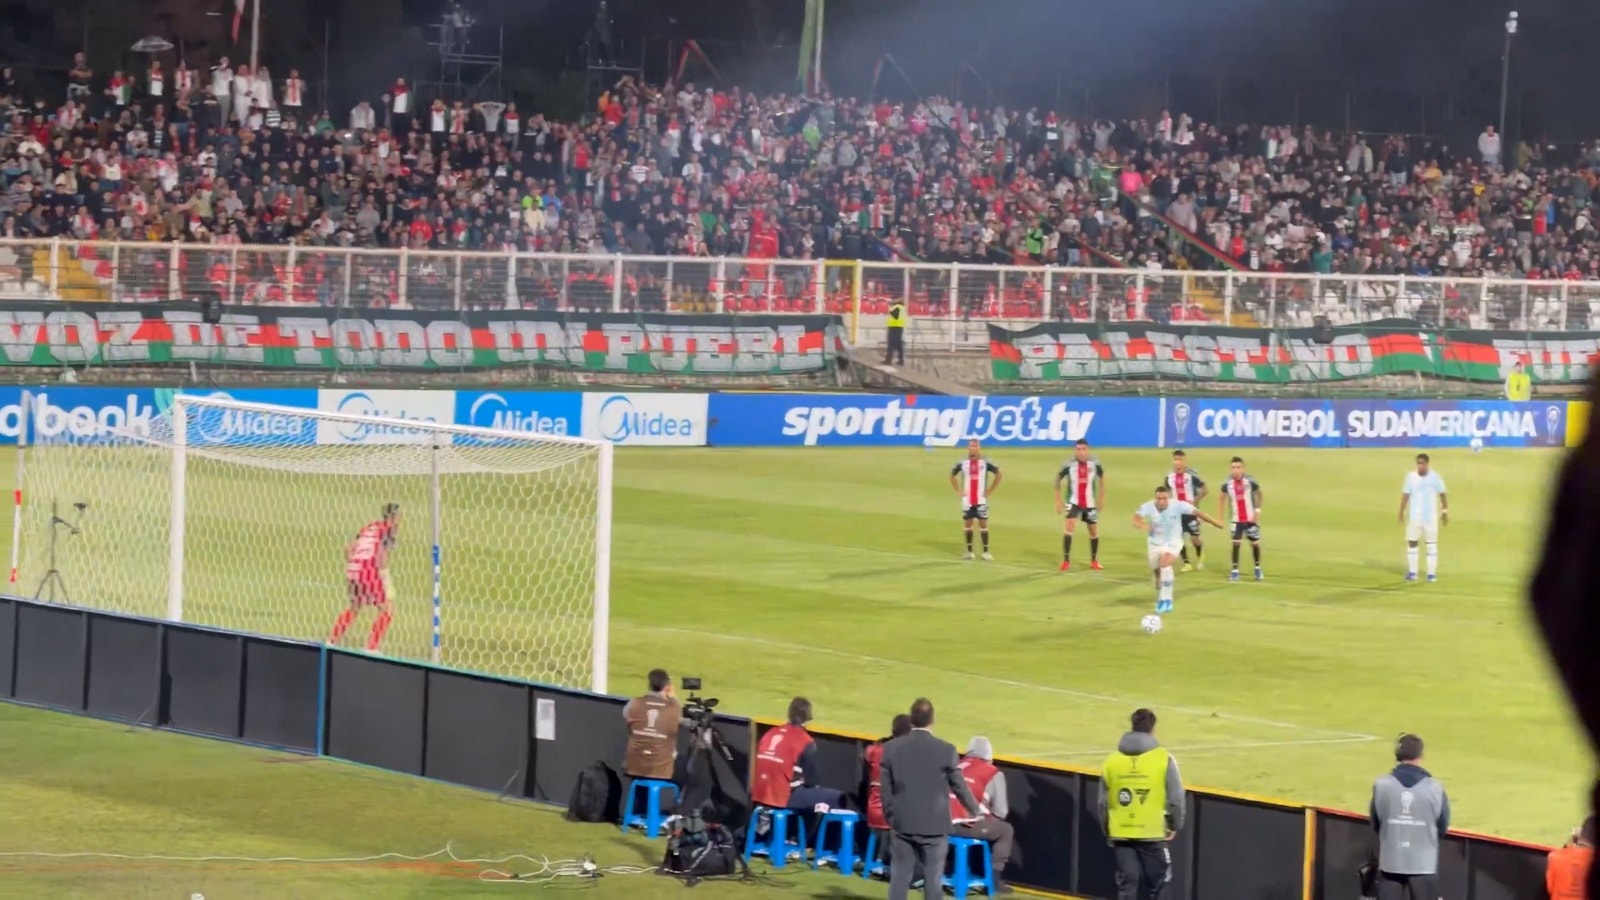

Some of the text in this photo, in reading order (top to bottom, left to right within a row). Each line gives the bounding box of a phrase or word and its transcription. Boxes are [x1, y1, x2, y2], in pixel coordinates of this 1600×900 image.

[277, 315, 474, 368] TODO
[221, 409, 302, 435] Midea
[494, 409, 568, 435] Midea
[618, 410, 692, 436] Midea
[782, 394, 1094, 447] sportingbet.tv
[1197, 408, 1537, 439] CONMEBOL SUDAMERICANA
